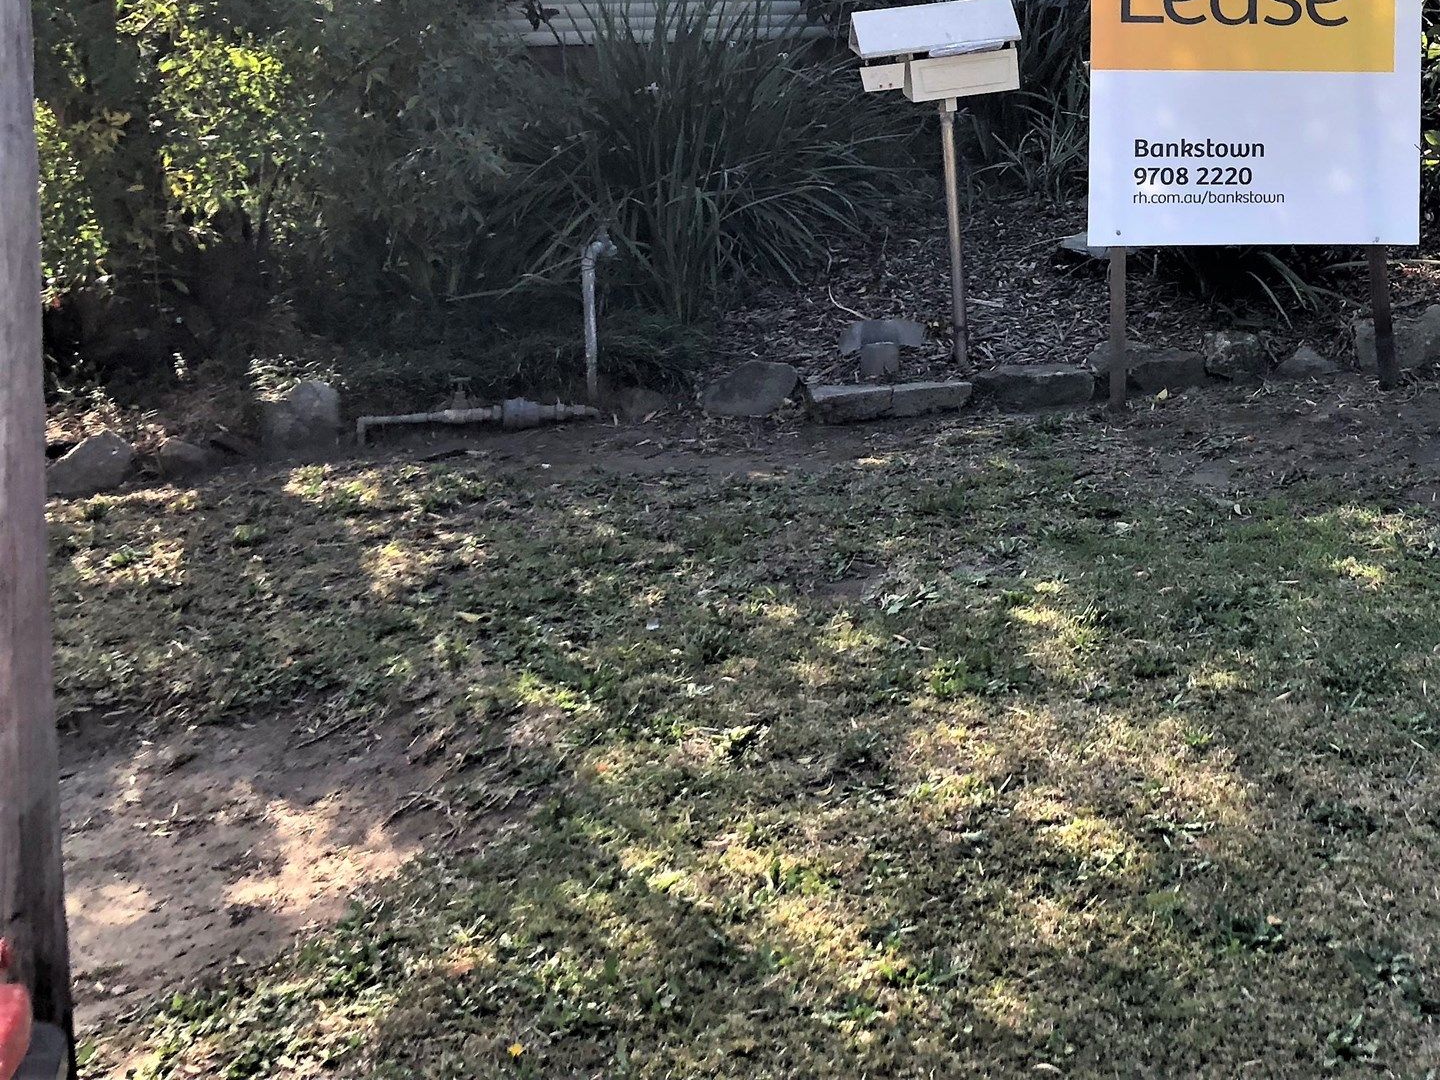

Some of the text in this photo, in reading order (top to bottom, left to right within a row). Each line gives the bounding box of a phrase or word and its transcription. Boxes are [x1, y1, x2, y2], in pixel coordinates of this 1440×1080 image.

[1133, 139, 1265, 158] Bankstown
[1133, 167, 1253, 185] 9708 2220
[1133, 190, 1285, 204] rh.com.au/bankstown
